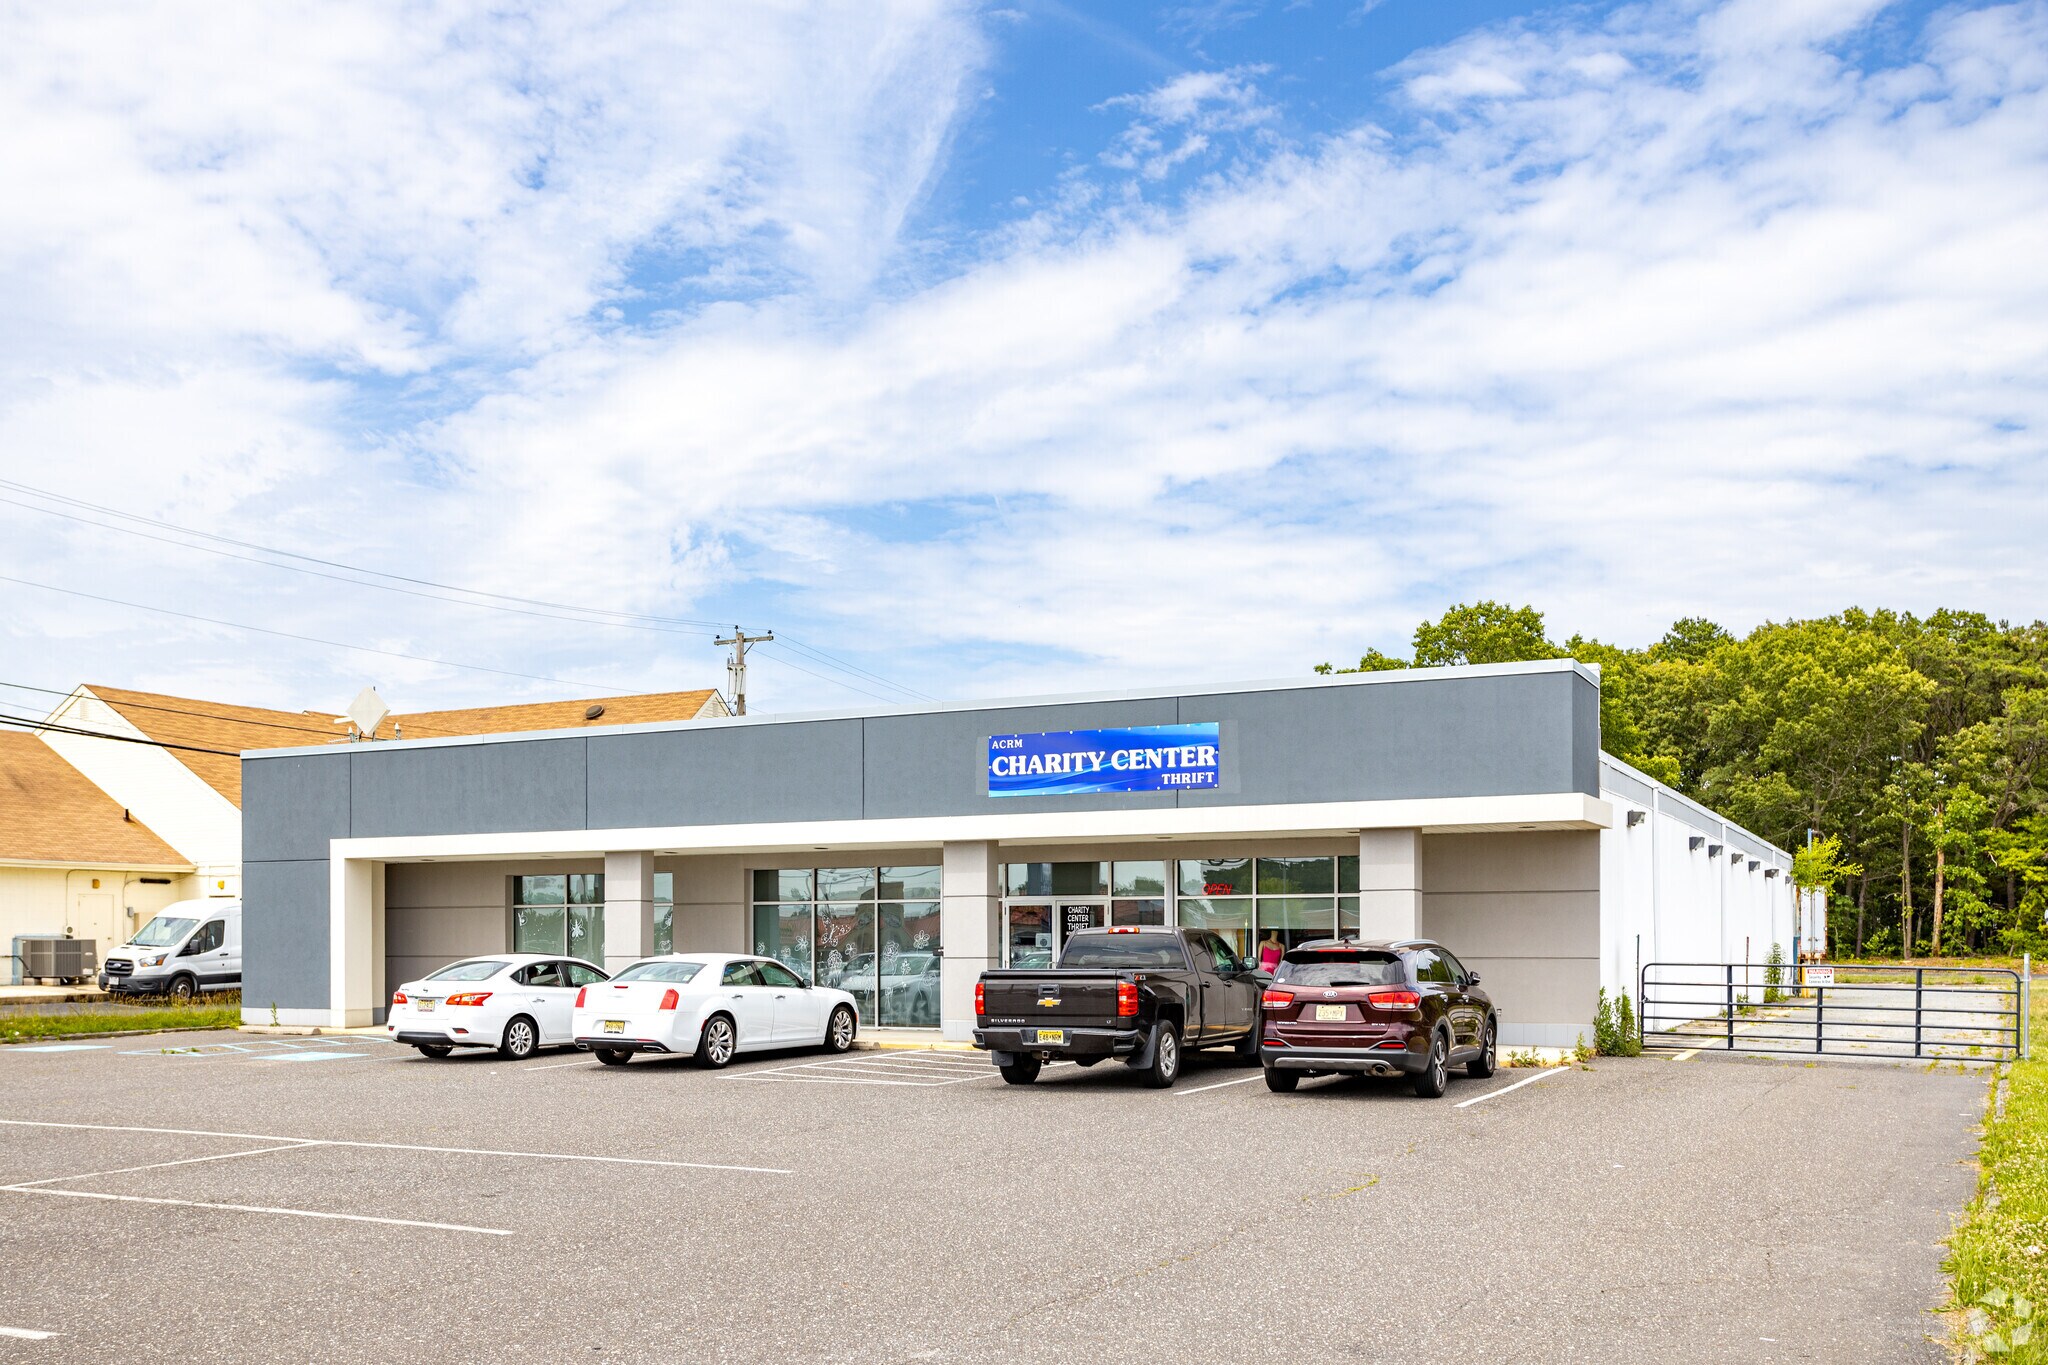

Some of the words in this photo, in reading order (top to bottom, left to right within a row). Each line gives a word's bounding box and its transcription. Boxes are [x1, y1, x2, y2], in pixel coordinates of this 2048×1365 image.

[992, 739, 1023, 749] ACRM
[992, 751, 1105, 777] CHARITY
[1111, 745, 1217, 770] CENTER
[1162, 772, 1215, 785] THRIFT
[1202, 883, 1233, 896] OPEN
[1067, 906, 1090, 914] CHARITY
[1067, 914, 1090, 922] CENTER
[1067, 922, 1089, 930] THRIFT
